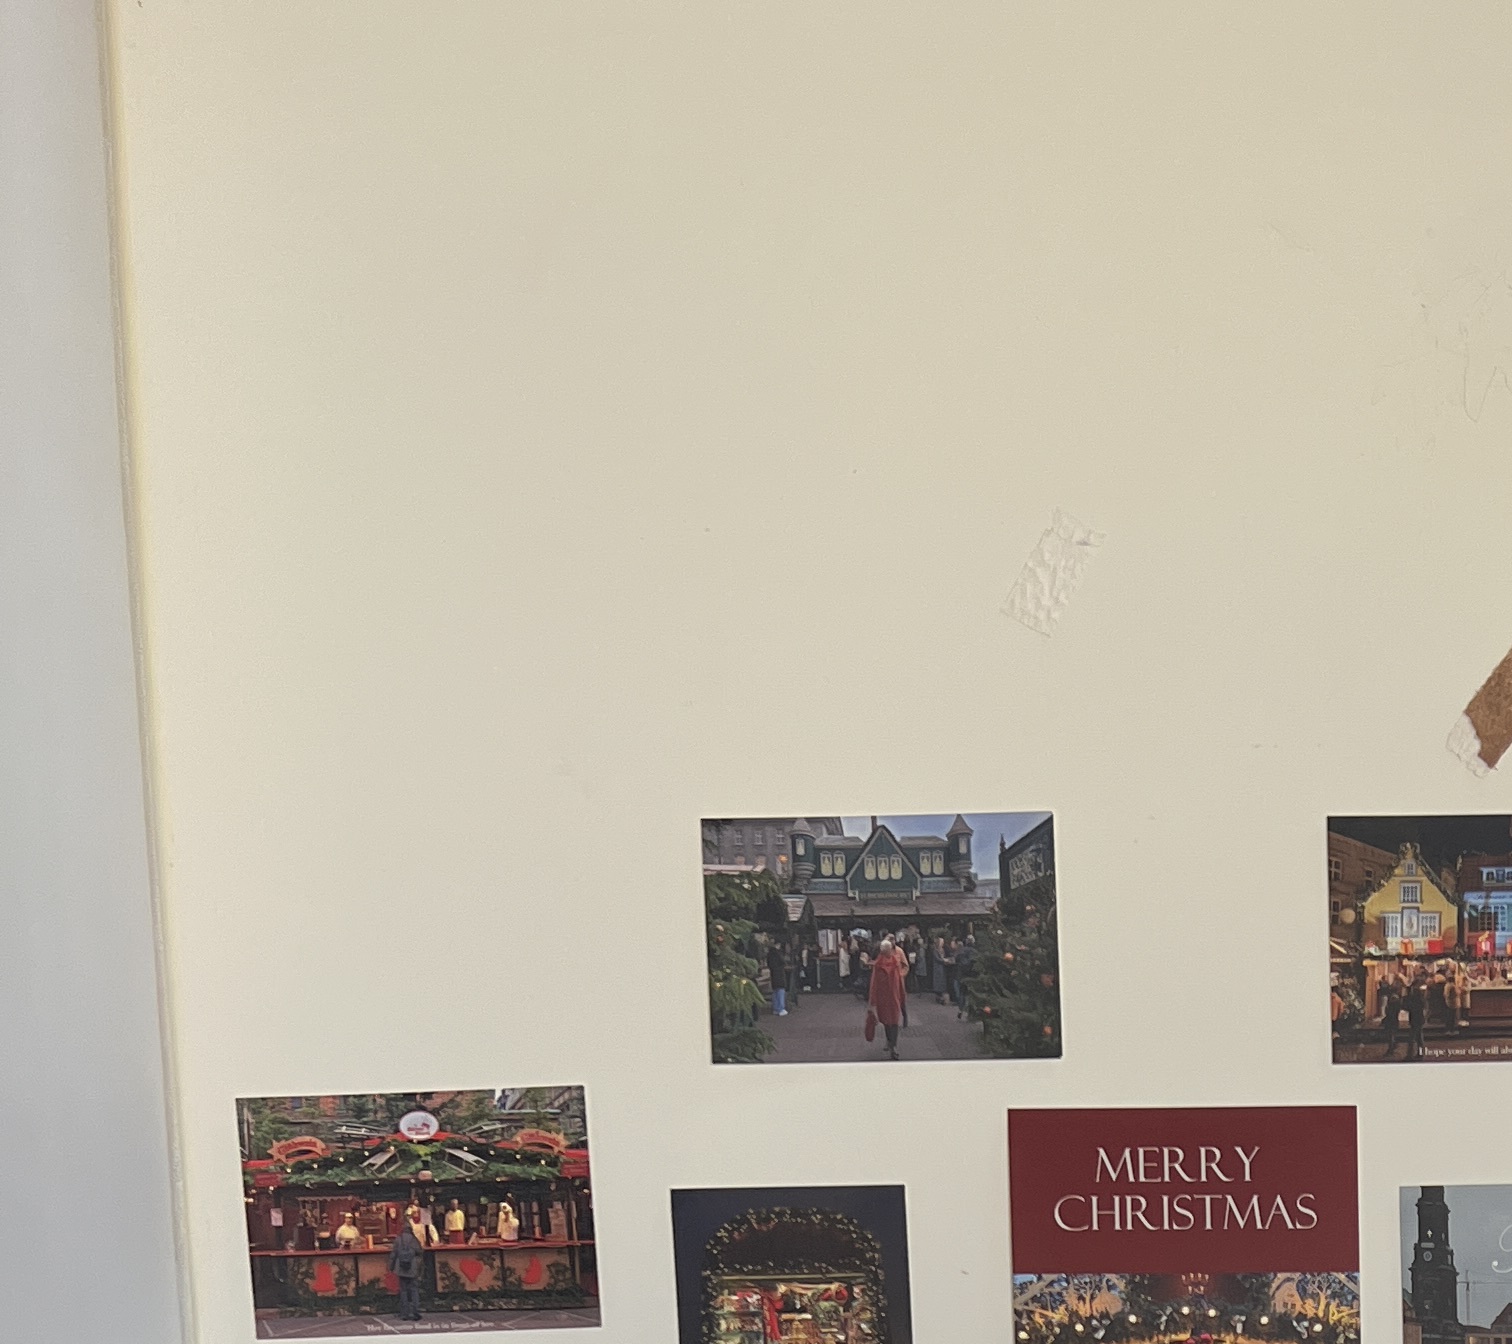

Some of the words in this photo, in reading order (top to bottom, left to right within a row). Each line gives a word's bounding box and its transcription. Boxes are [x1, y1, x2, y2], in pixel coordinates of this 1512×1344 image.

[1419, 1047, 1423, 1057] I
[1425, 1047, 1444, 1056] hope
[1448, 1047, 1466, 1056] your
[1468, 1047, 1481, 1056] day
[1485, 1047, 1499, 1056] will
[1095, 1146, 1260, 1183] MERRY
[1054, 1193, 1318, 1232] CHRISTMAS
